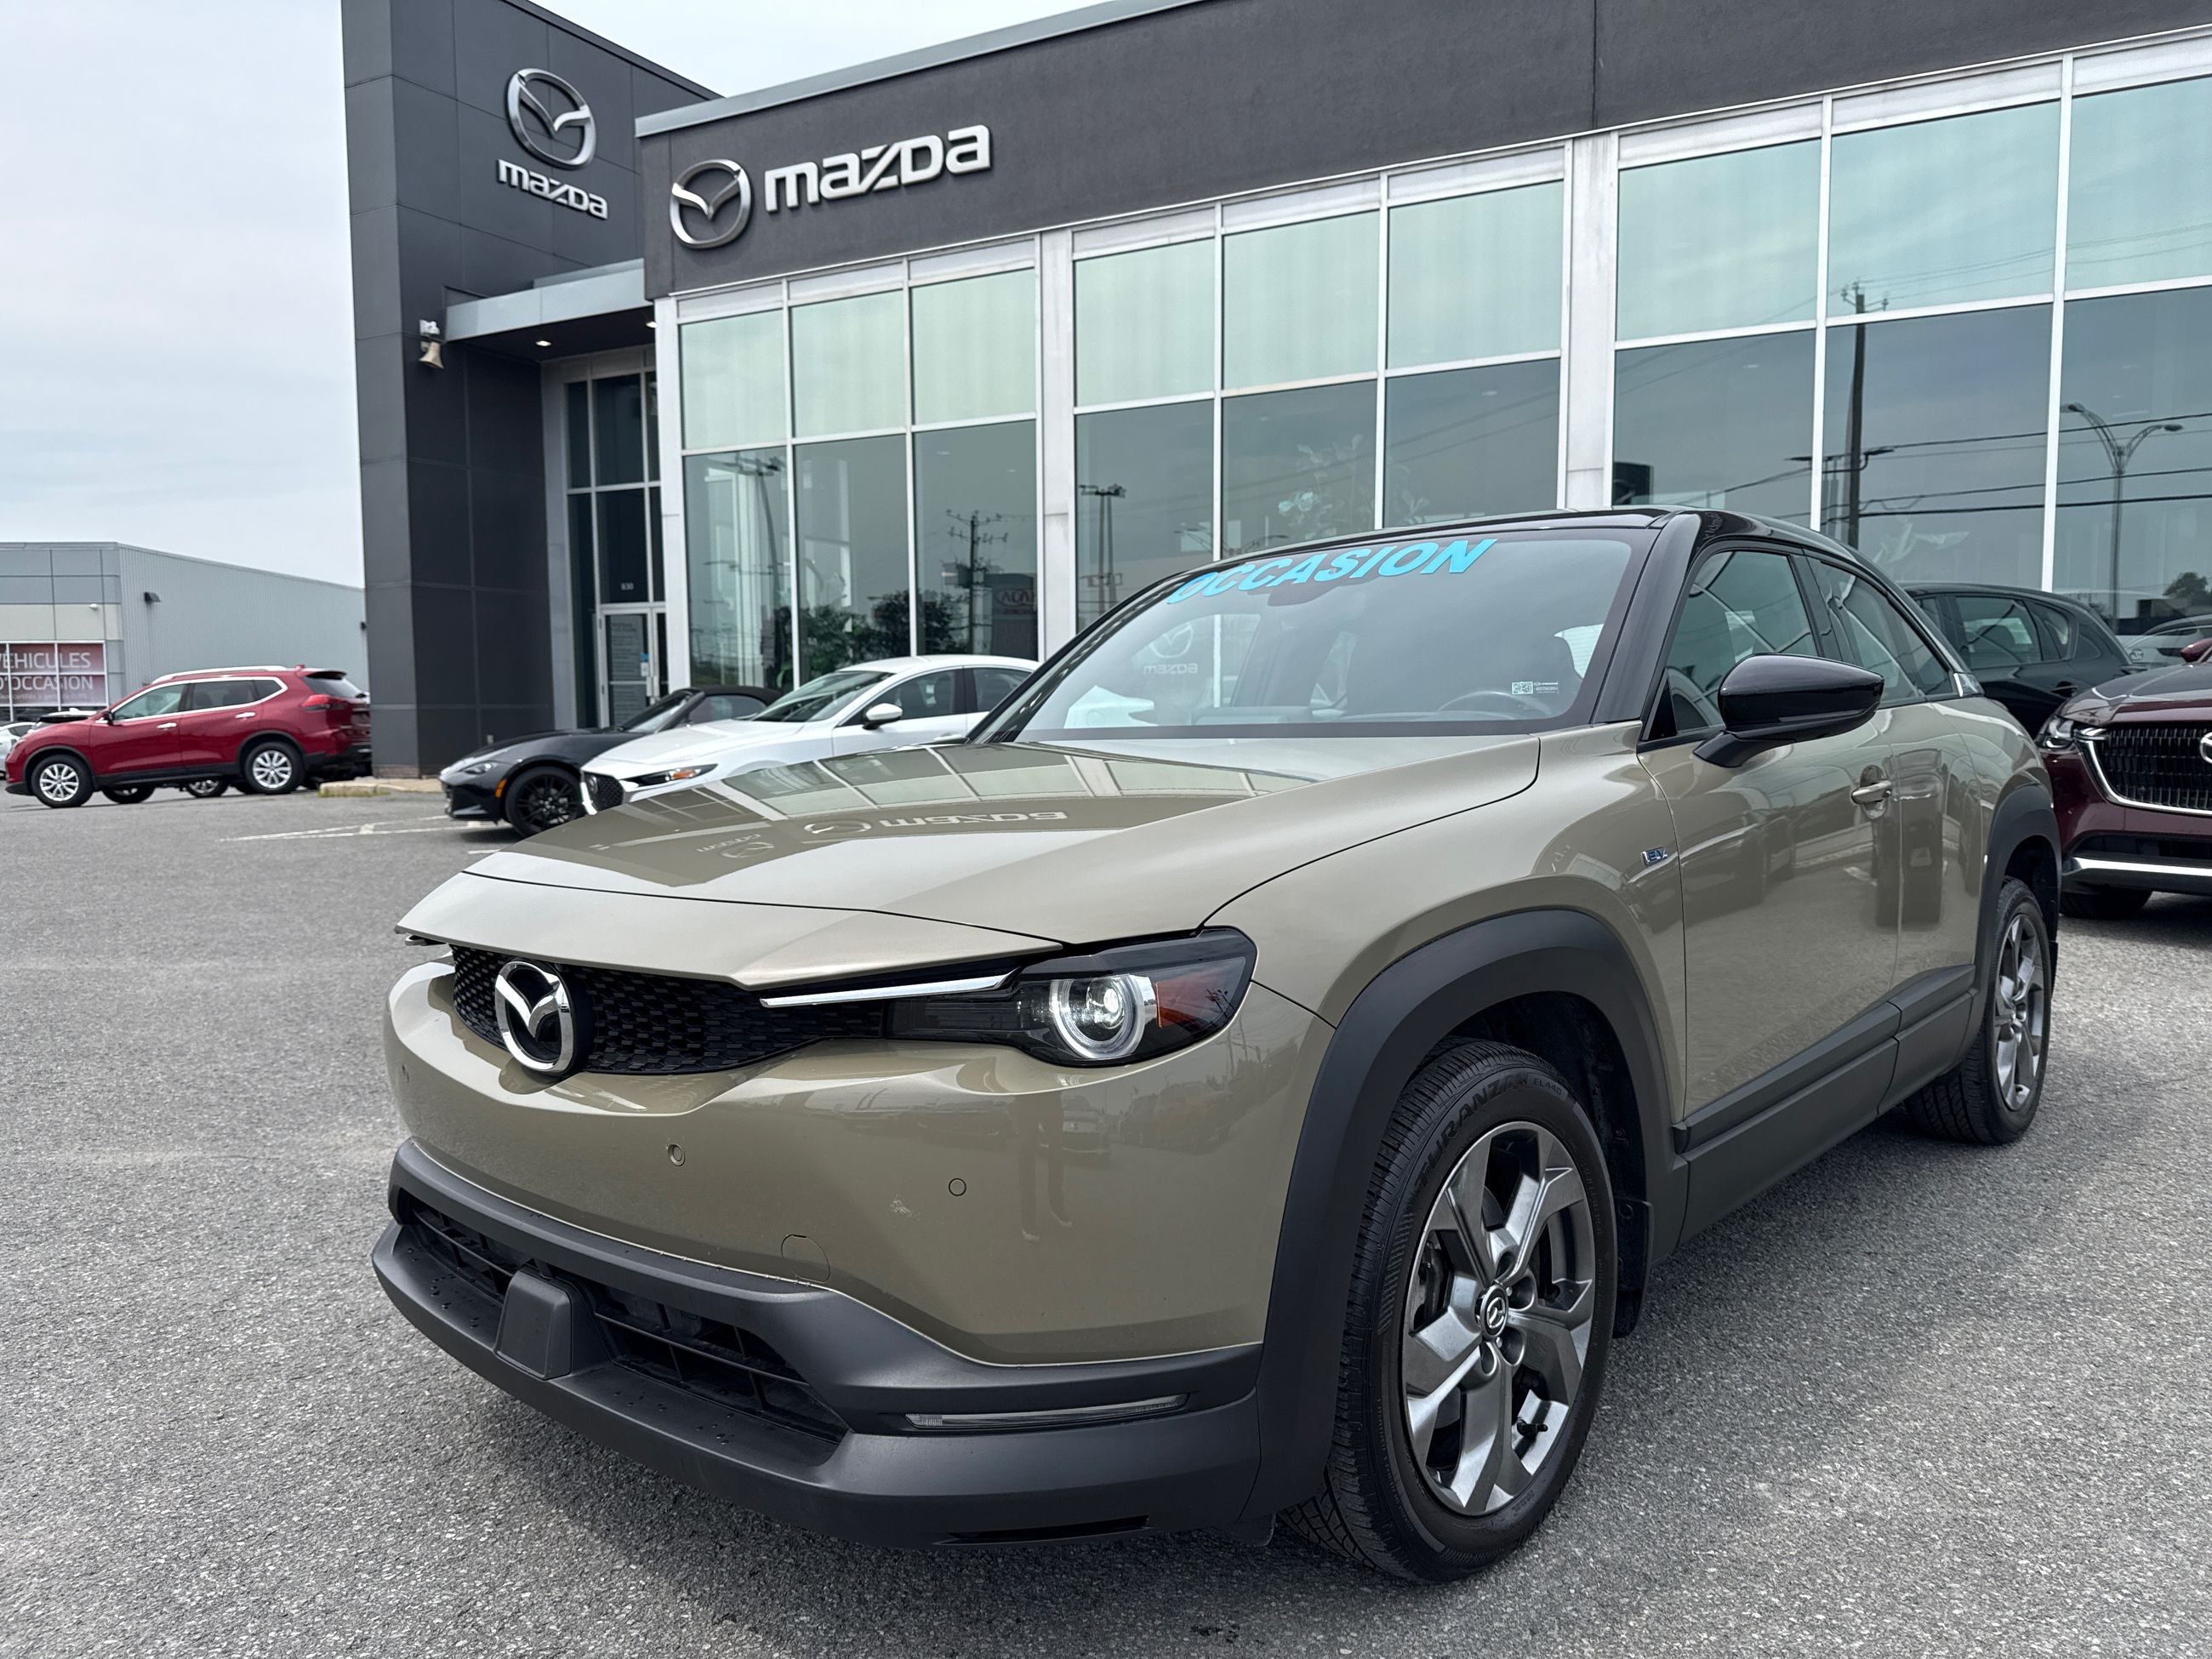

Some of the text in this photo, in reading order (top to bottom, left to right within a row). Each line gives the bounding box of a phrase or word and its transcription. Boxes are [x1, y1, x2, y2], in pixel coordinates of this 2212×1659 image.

[497, 159, 608, 220] mazda
[765, 124, 992, 213] mazda
[1166, 539, 1497, 603] OCCASION
